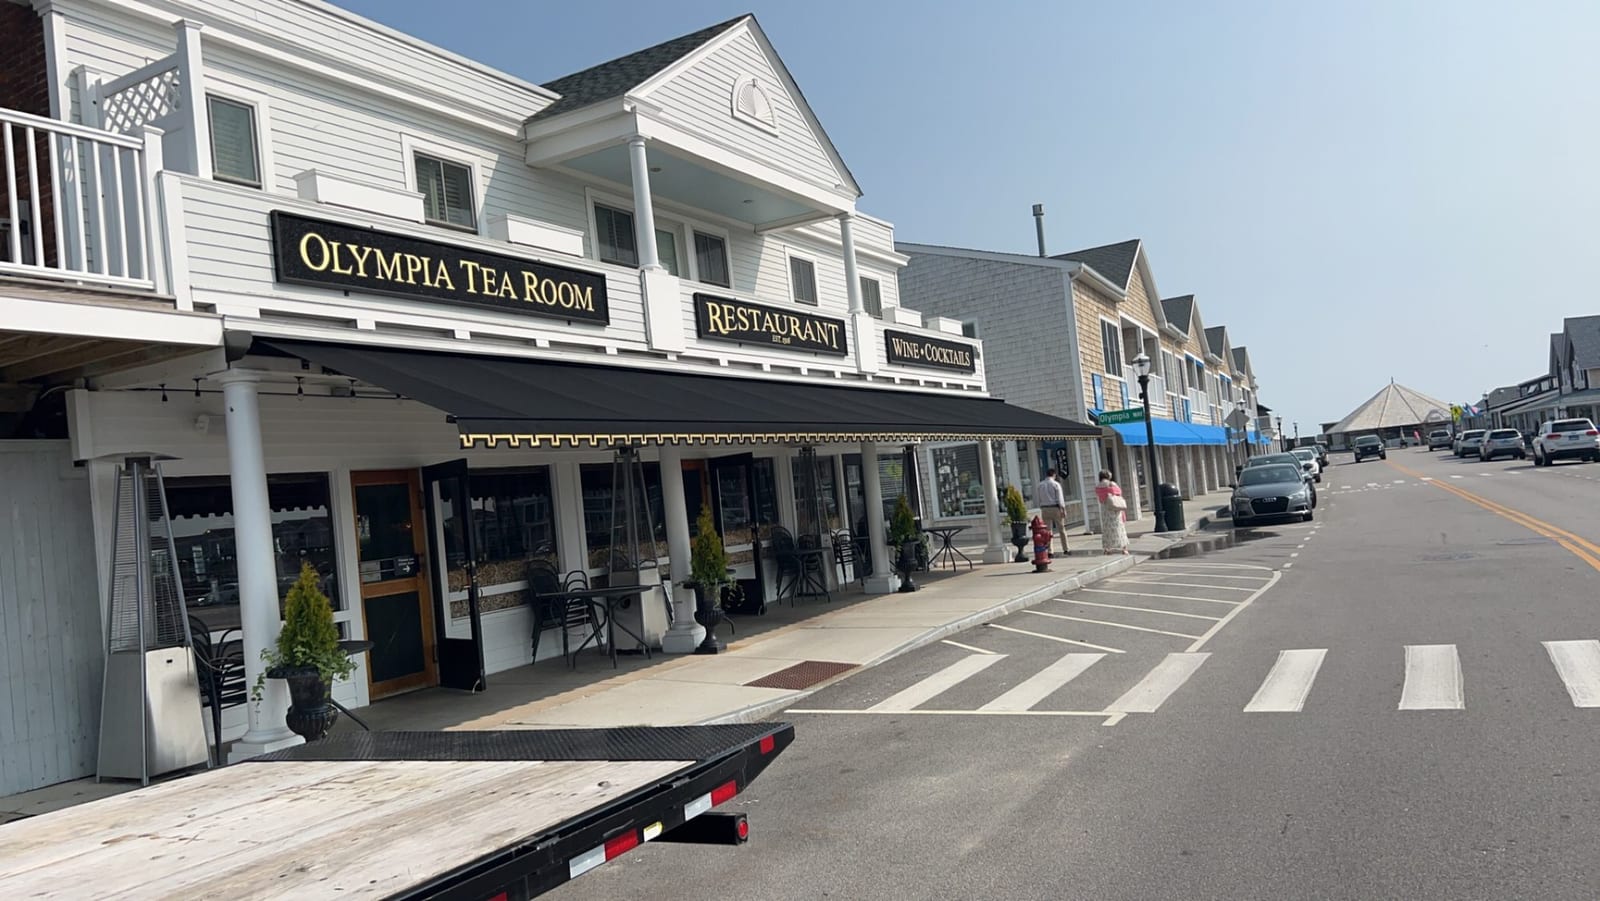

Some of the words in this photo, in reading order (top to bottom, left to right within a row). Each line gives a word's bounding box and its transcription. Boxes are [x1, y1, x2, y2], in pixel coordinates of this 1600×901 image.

[299, 232, 456, 291] OLYMPIA
[459, 260, 518, 300] TEA
[521, 270, 595, 312] ROOM
[706, 302, 839, 349] RESTAURANT
[924, 343, 971, 367] COCKTAILS
[1100, 412, 1130, 423] Olympia
